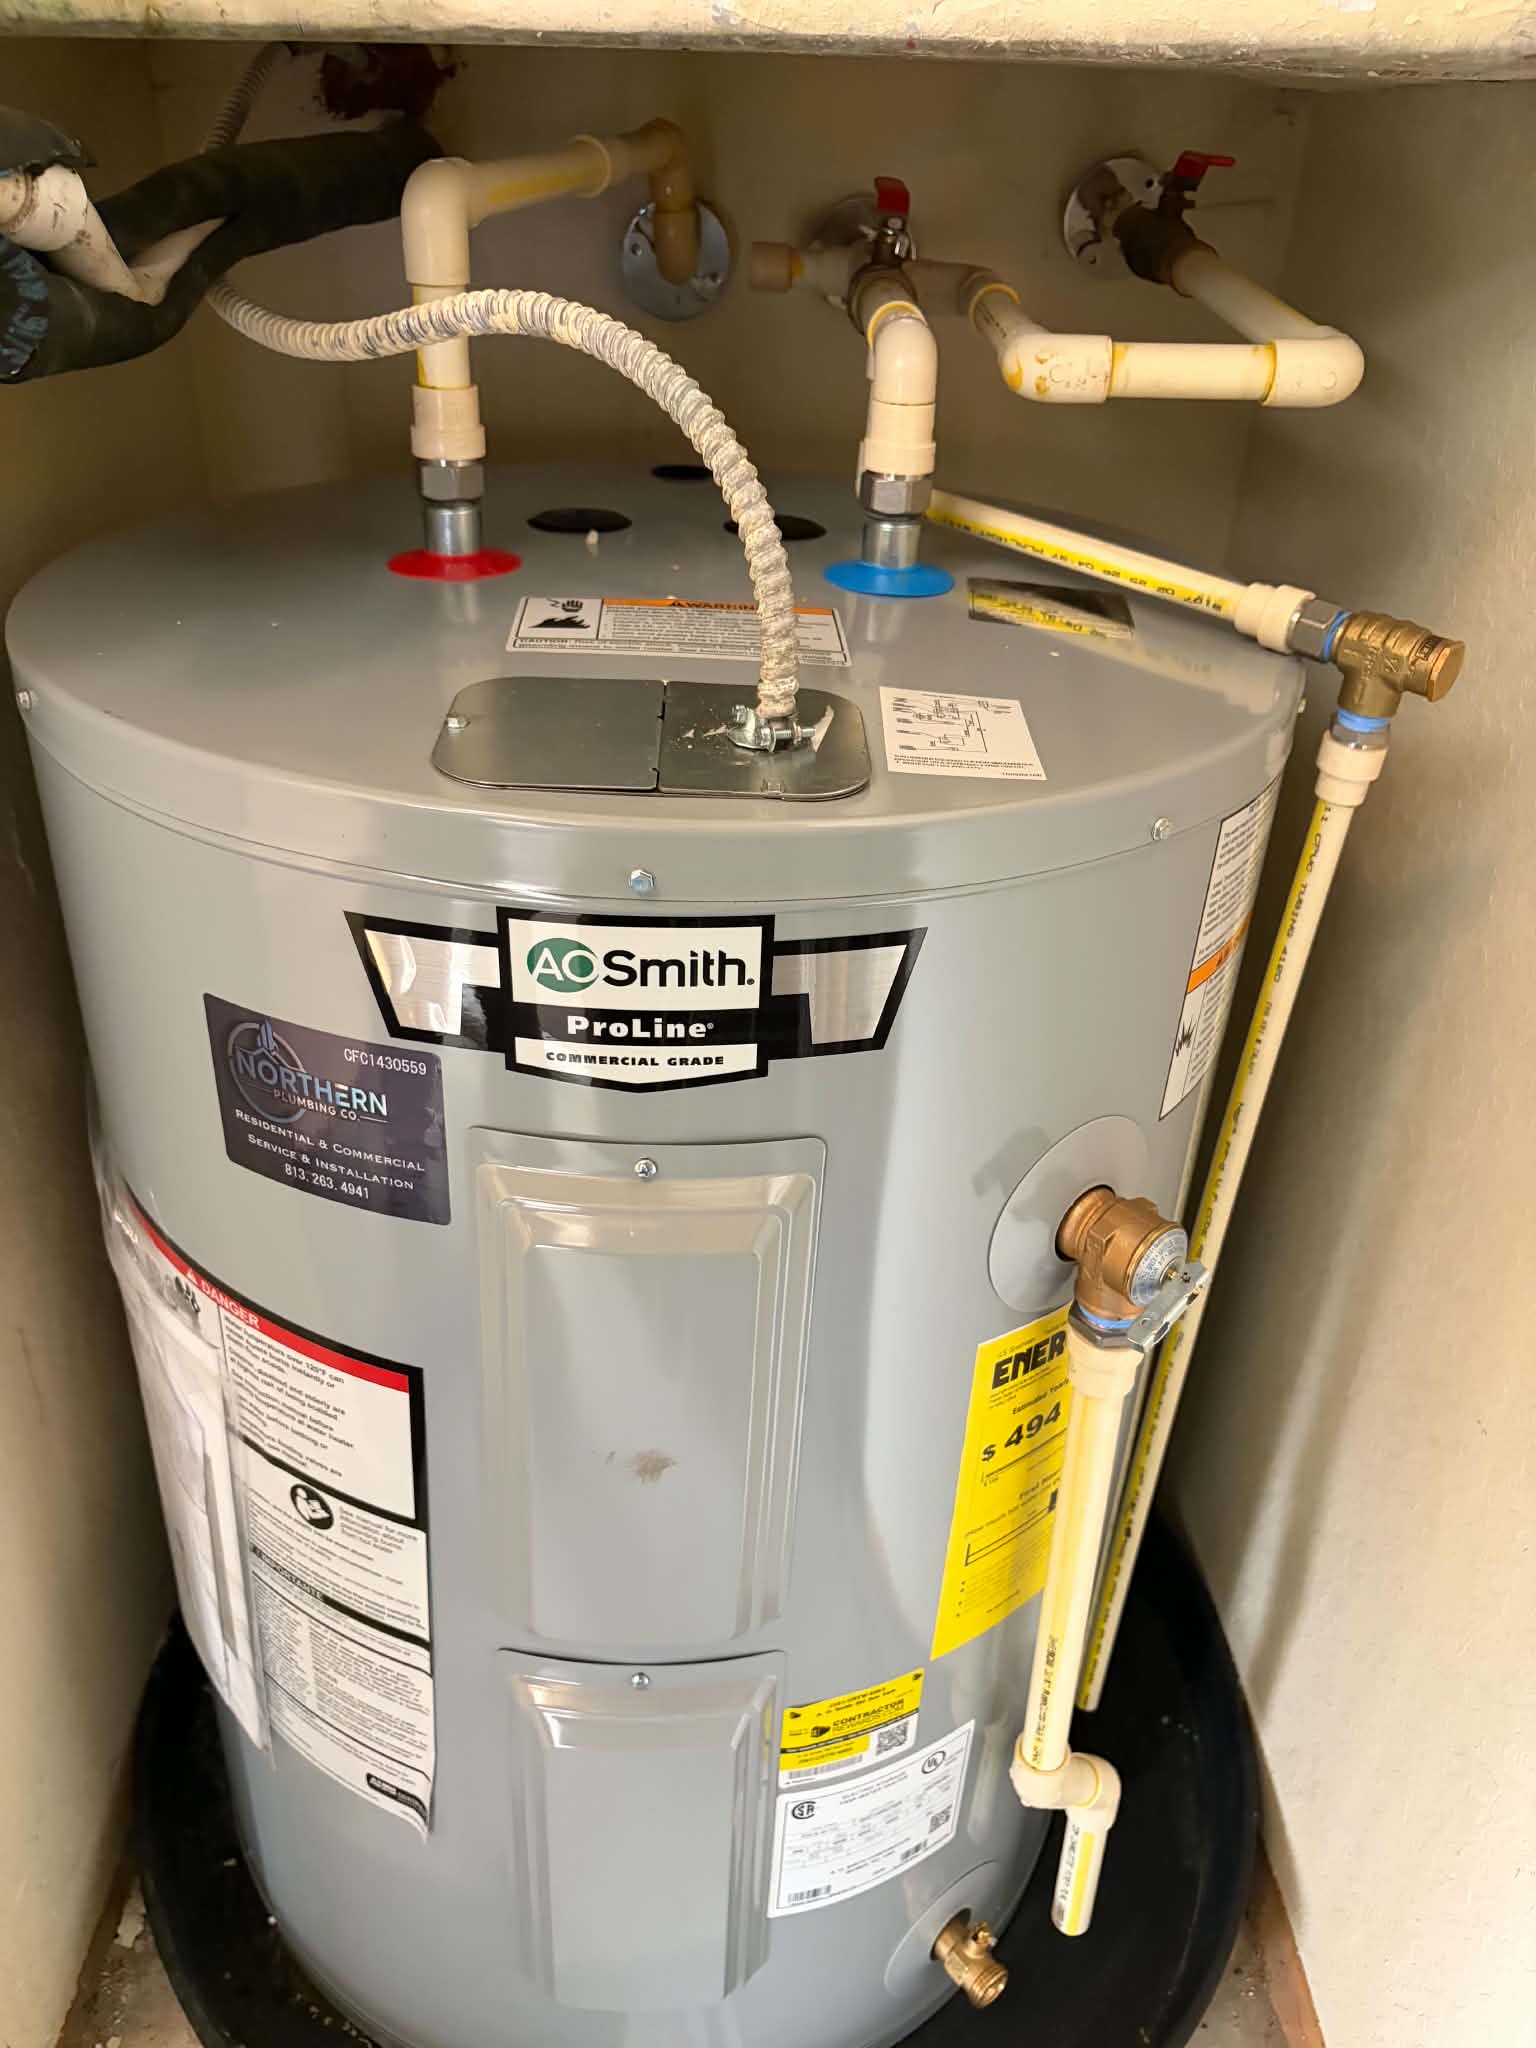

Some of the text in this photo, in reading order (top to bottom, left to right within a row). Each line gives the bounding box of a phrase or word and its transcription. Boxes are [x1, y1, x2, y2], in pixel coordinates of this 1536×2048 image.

[237, 1050, 388, 1116] NORTHERN
[344, 1048, 427, 1075] CFC1430559
[546, 1051, 724, 1066] COMMERCIAL GRADE
[273, 1088, 361, 1121] PLUMBING CO.
[235, 1109, 425, 1172] RESIDENTIAL & COMMERCIAL
[248, 1134, 414, 1190] SERVICE & INSTALLATION
[201, 1281, 260, 1329] DANGER
[992, 1330, 1066, 1390] ENER
[981, 1402, 1061, 1462] $ 494
[832, 1698, 905, 1727] CONTRACTOR
